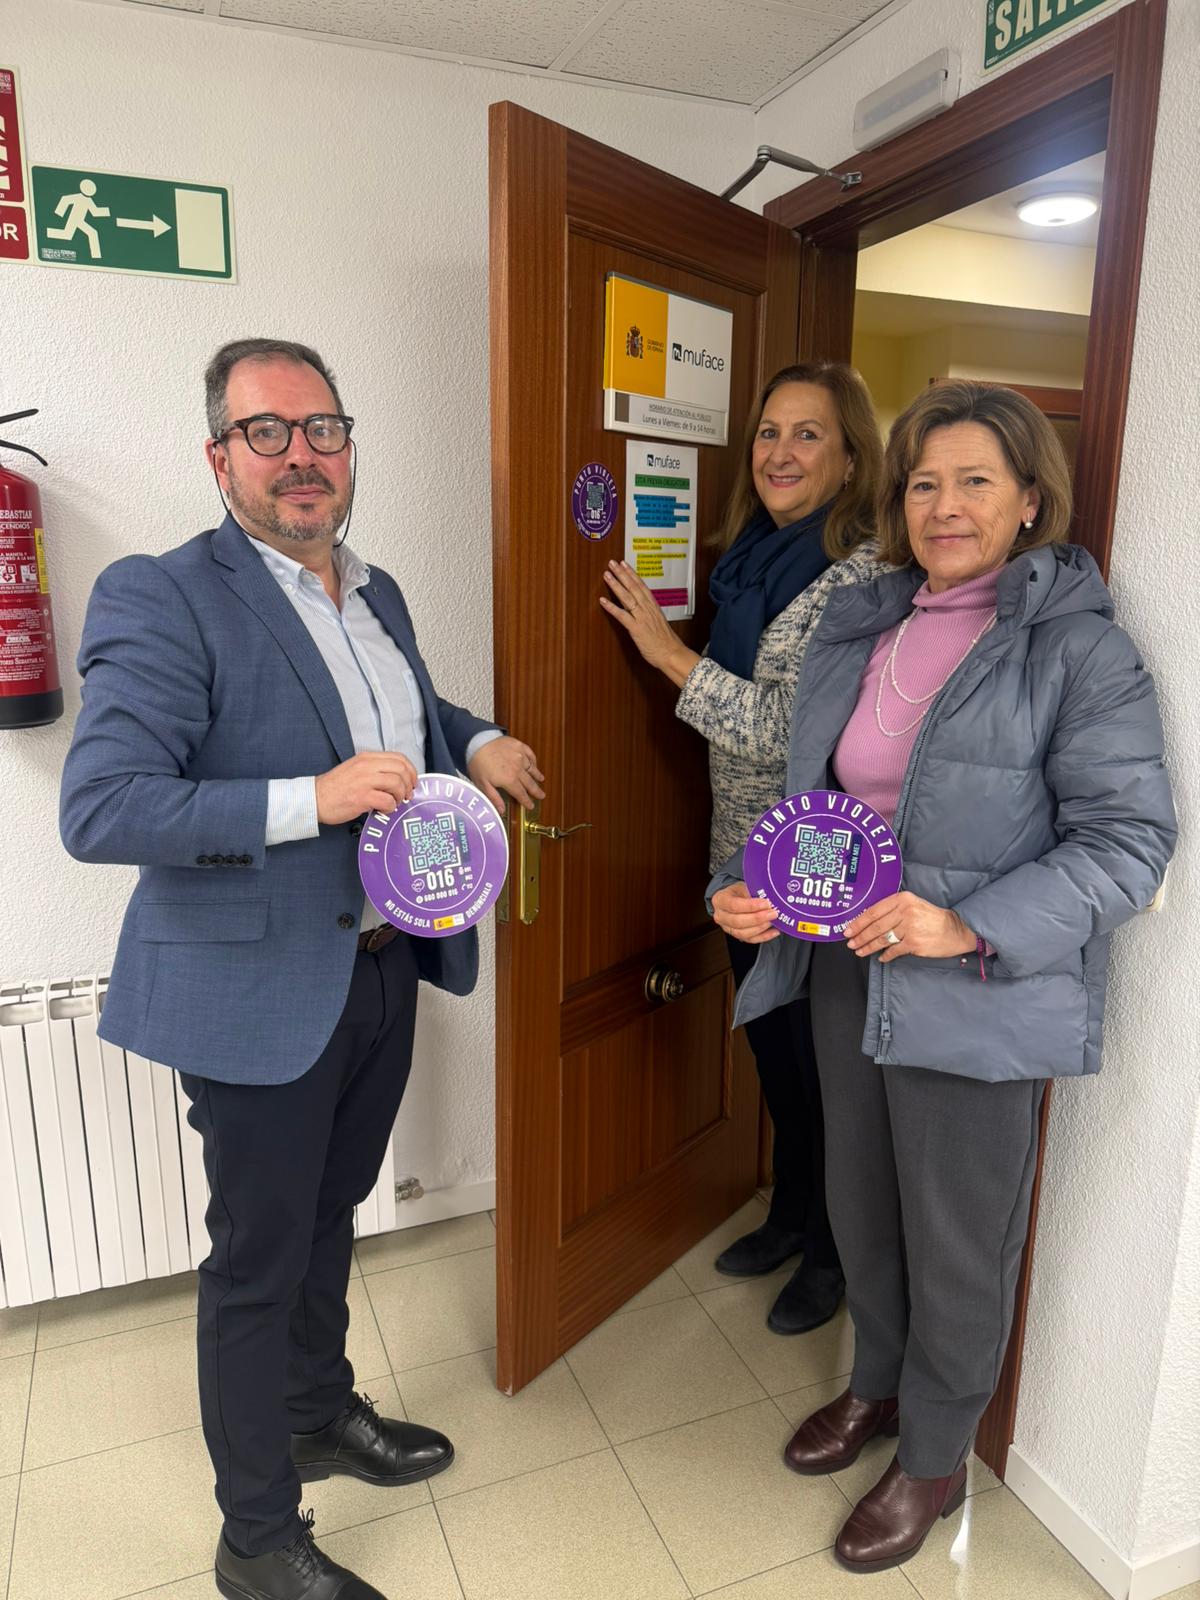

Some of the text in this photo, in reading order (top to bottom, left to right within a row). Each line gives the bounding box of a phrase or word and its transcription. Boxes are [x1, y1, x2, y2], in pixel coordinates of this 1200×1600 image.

[0, 222, 20, 242] R
[683, 349, 725, 372] muface
[642, 415, 658, 425] Lunes
[682, 420, 688, 430] de
[697, 423, 703, 432] 14
[655, 455, 681, 469] muface
[574, 465, 617, 498] PUNTO VIOLETA
[590, 510, 600, 519] 016
[420, 780, 497, 833] VIOLETA
[753, 794, 897, 863] PUNTO VIOLETA
[849, 856, 859, 874] SCAN
[426, 868, 455, 890] 016
[802, 878, 832, 898] 016
[465, 882, 493, 918] DENÚNCIALO
[795, 897, 832, 908] 600 000 016
[384, 899, 394, 911] NO
[393, 907, 414, 925] ESTÁS
[414, 917, 431, 928] SOLA
[778, 912, 795, 927] SOLA
